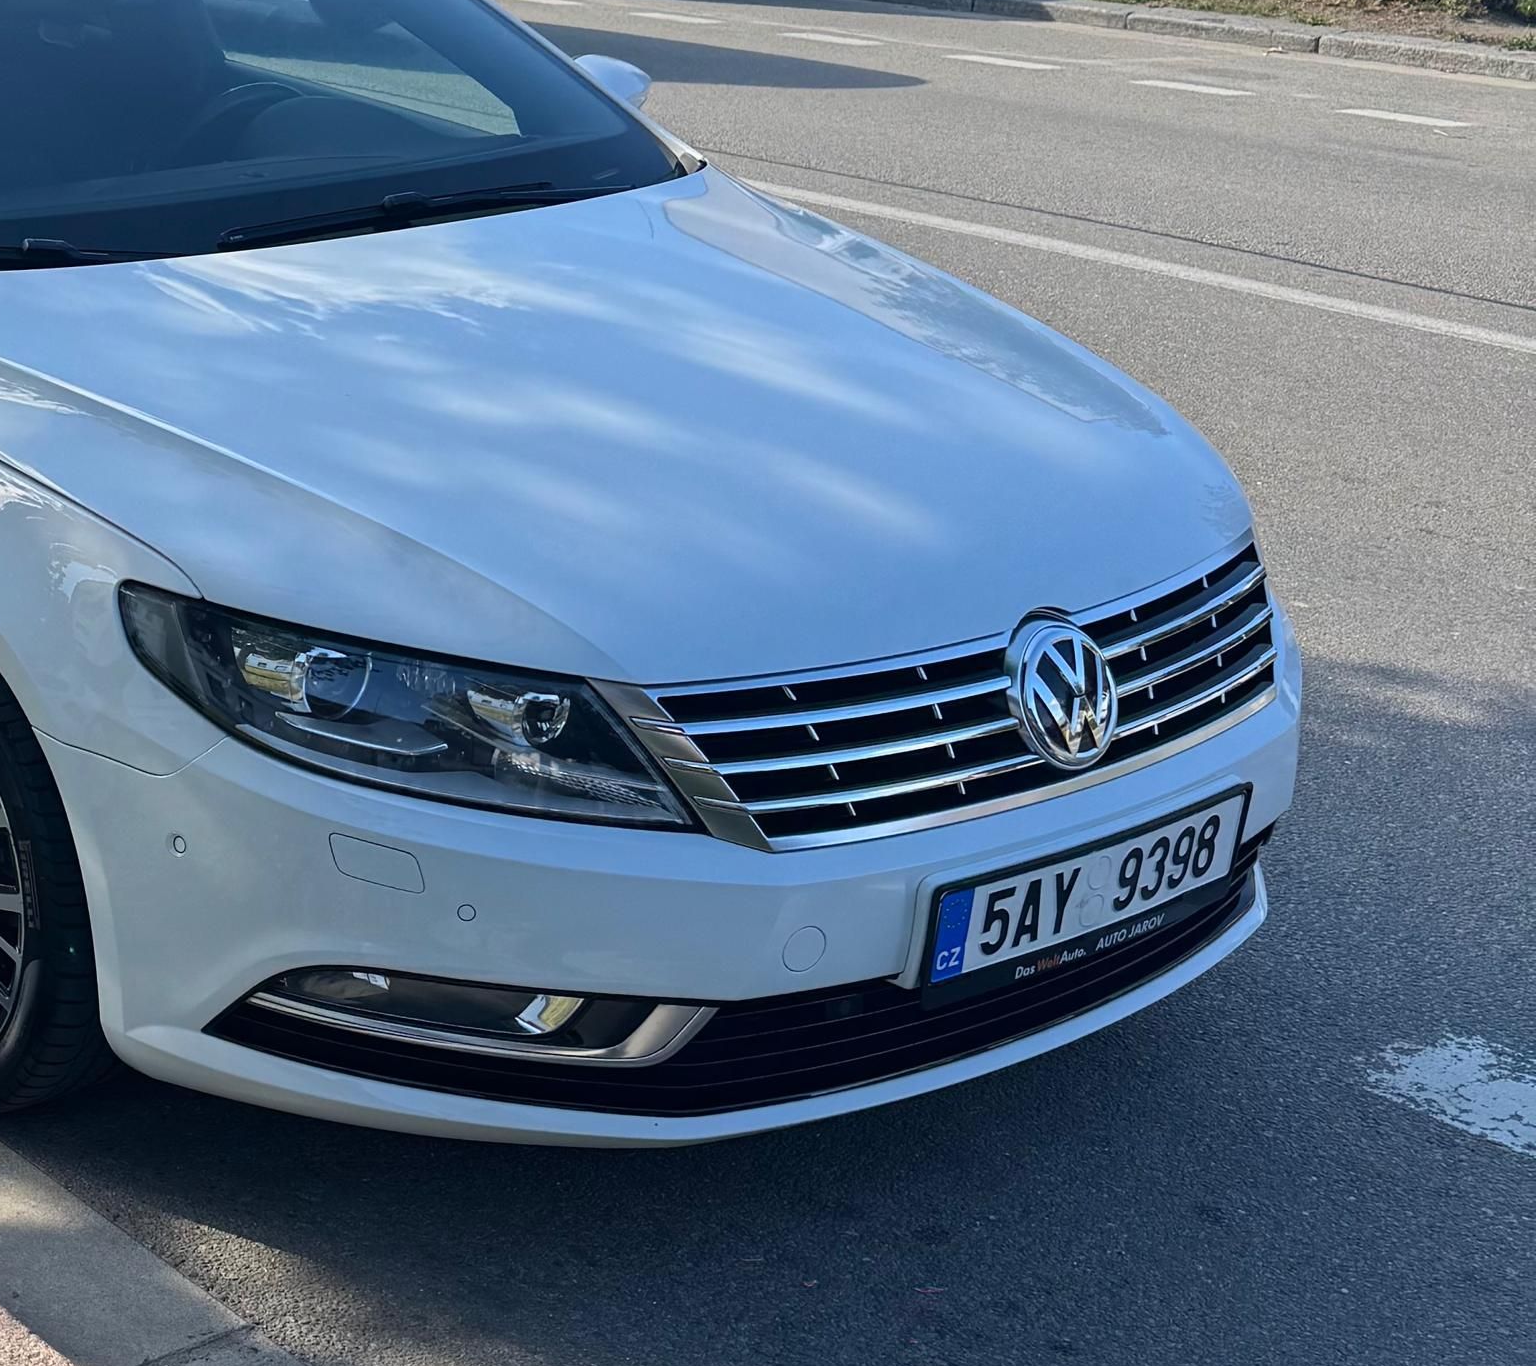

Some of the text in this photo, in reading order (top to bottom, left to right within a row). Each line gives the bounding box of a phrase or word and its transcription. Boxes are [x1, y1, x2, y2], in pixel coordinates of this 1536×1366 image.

[979, 814, 1221, 956] 5AY 9398
[1095, 913, 1166, 951] AUTO JAROV
[935, 946, 961, 971] CZ
[1014, 966, 1036, 980] Das
